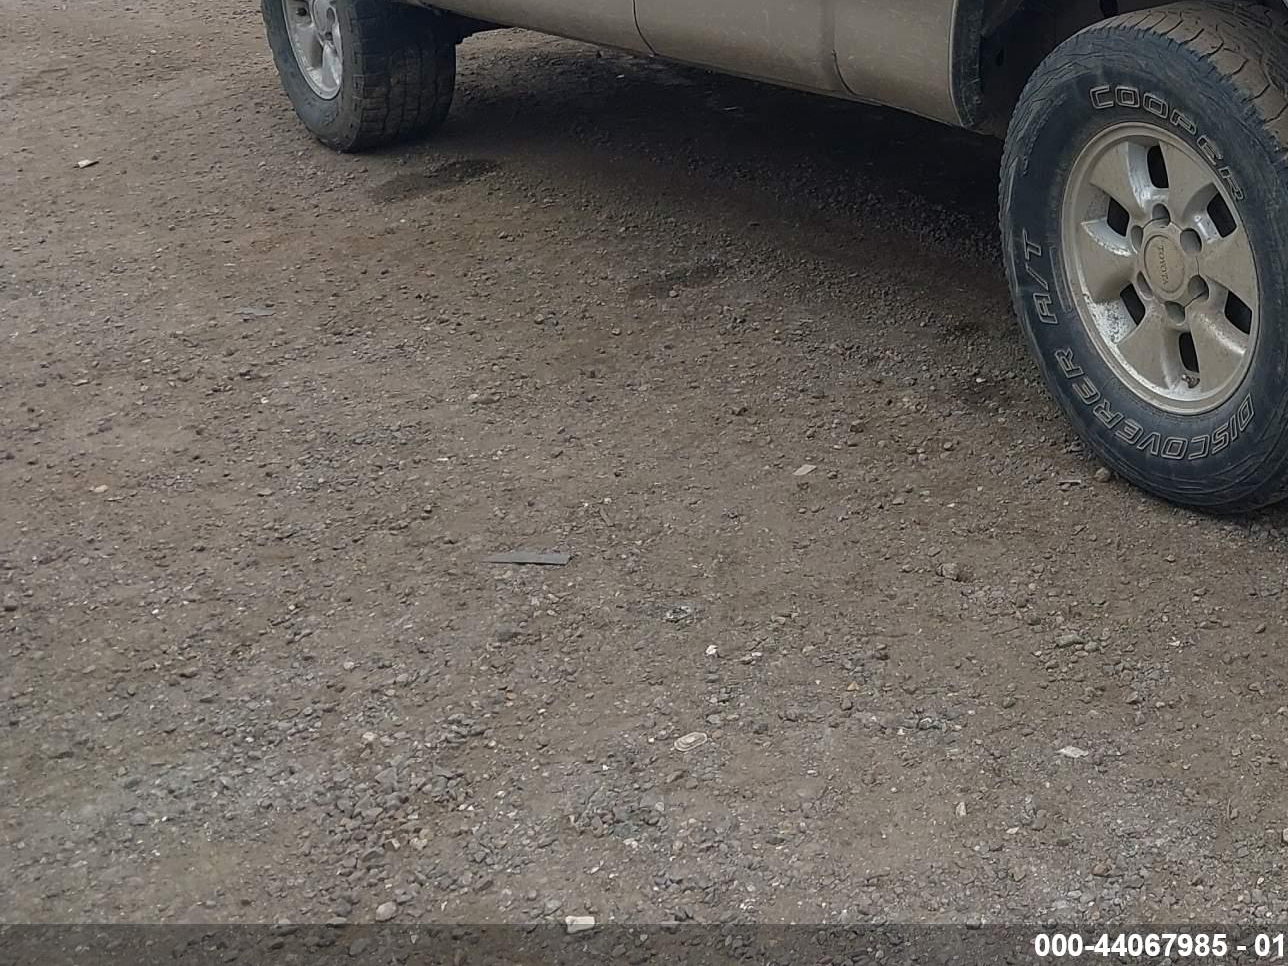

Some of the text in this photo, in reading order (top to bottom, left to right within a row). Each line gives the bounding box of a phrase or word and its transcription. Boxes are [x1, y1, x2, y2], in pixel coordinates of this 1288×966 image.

[1089, 85, 1244, 201] COOPER
[1157, 244, 1169, 285] TOYOTA
[1022, 227, 1256, 461] DISCOVERER A/T
